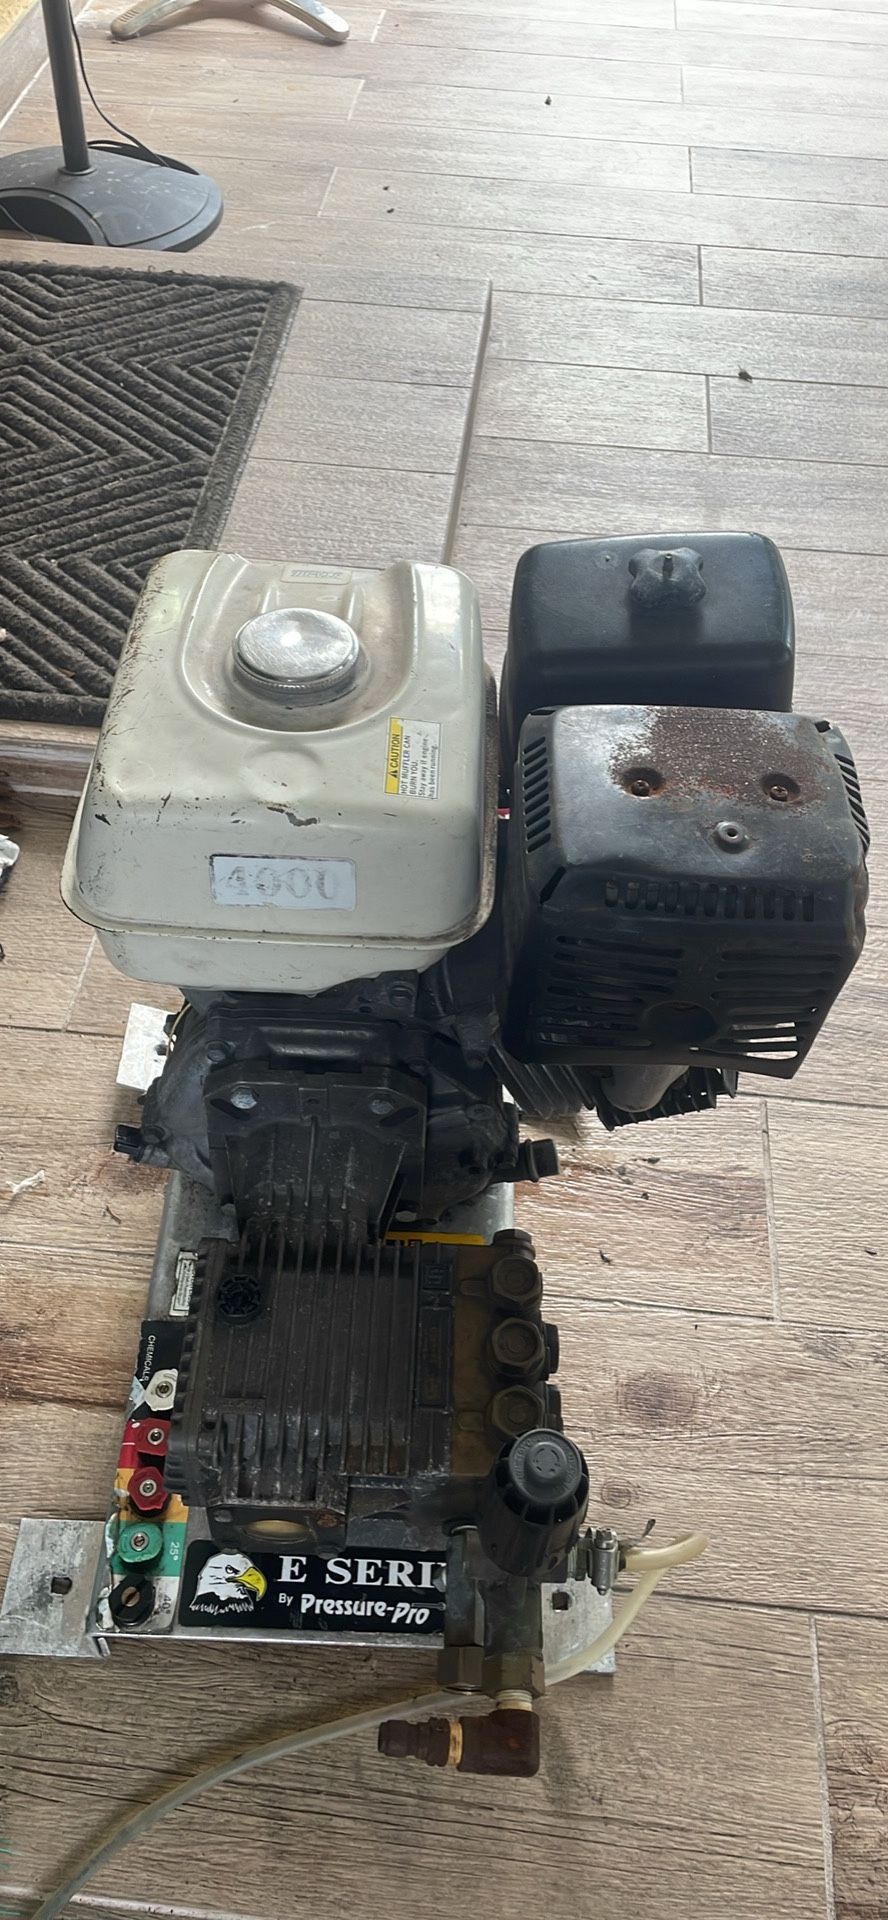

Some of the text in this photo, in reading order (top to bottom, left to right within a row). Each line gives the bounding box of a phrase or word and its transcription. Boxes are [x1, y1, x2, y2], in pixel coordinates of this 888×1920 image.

[390, 734, 400, 768] CAUTION
[403, 735, 411, 749] CAN
[421, 766, 429, 781] away
[418, 783, 427, 796] Stay
[141, 1335, 156, 1381] CHEMICALS
[169, 1541, 180, 1561] 25°
[276, 1555, 307, 1583] E
[278, 1593, 430, 1625] By Pressure-Pro
